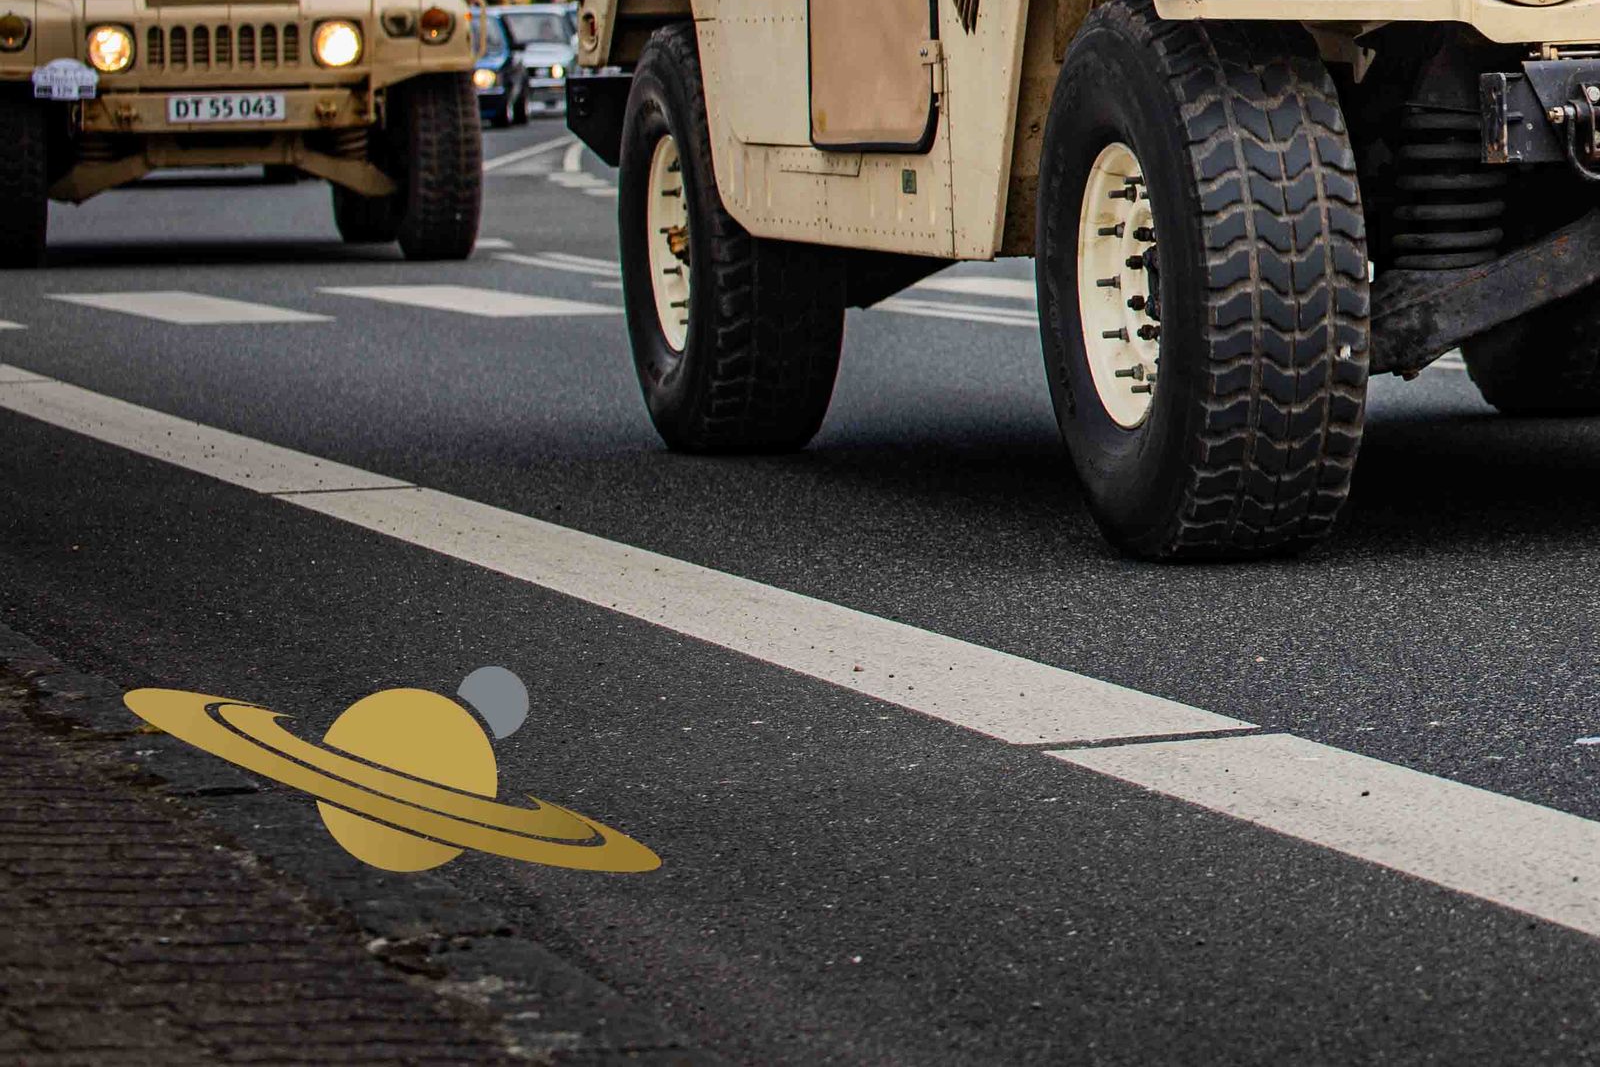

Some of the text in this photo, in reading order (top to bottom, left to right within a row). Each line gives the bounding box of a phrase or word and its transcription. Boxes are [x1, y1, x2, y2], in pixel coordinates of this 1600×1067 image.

[176, 95, 276, 118] DT 55 043
